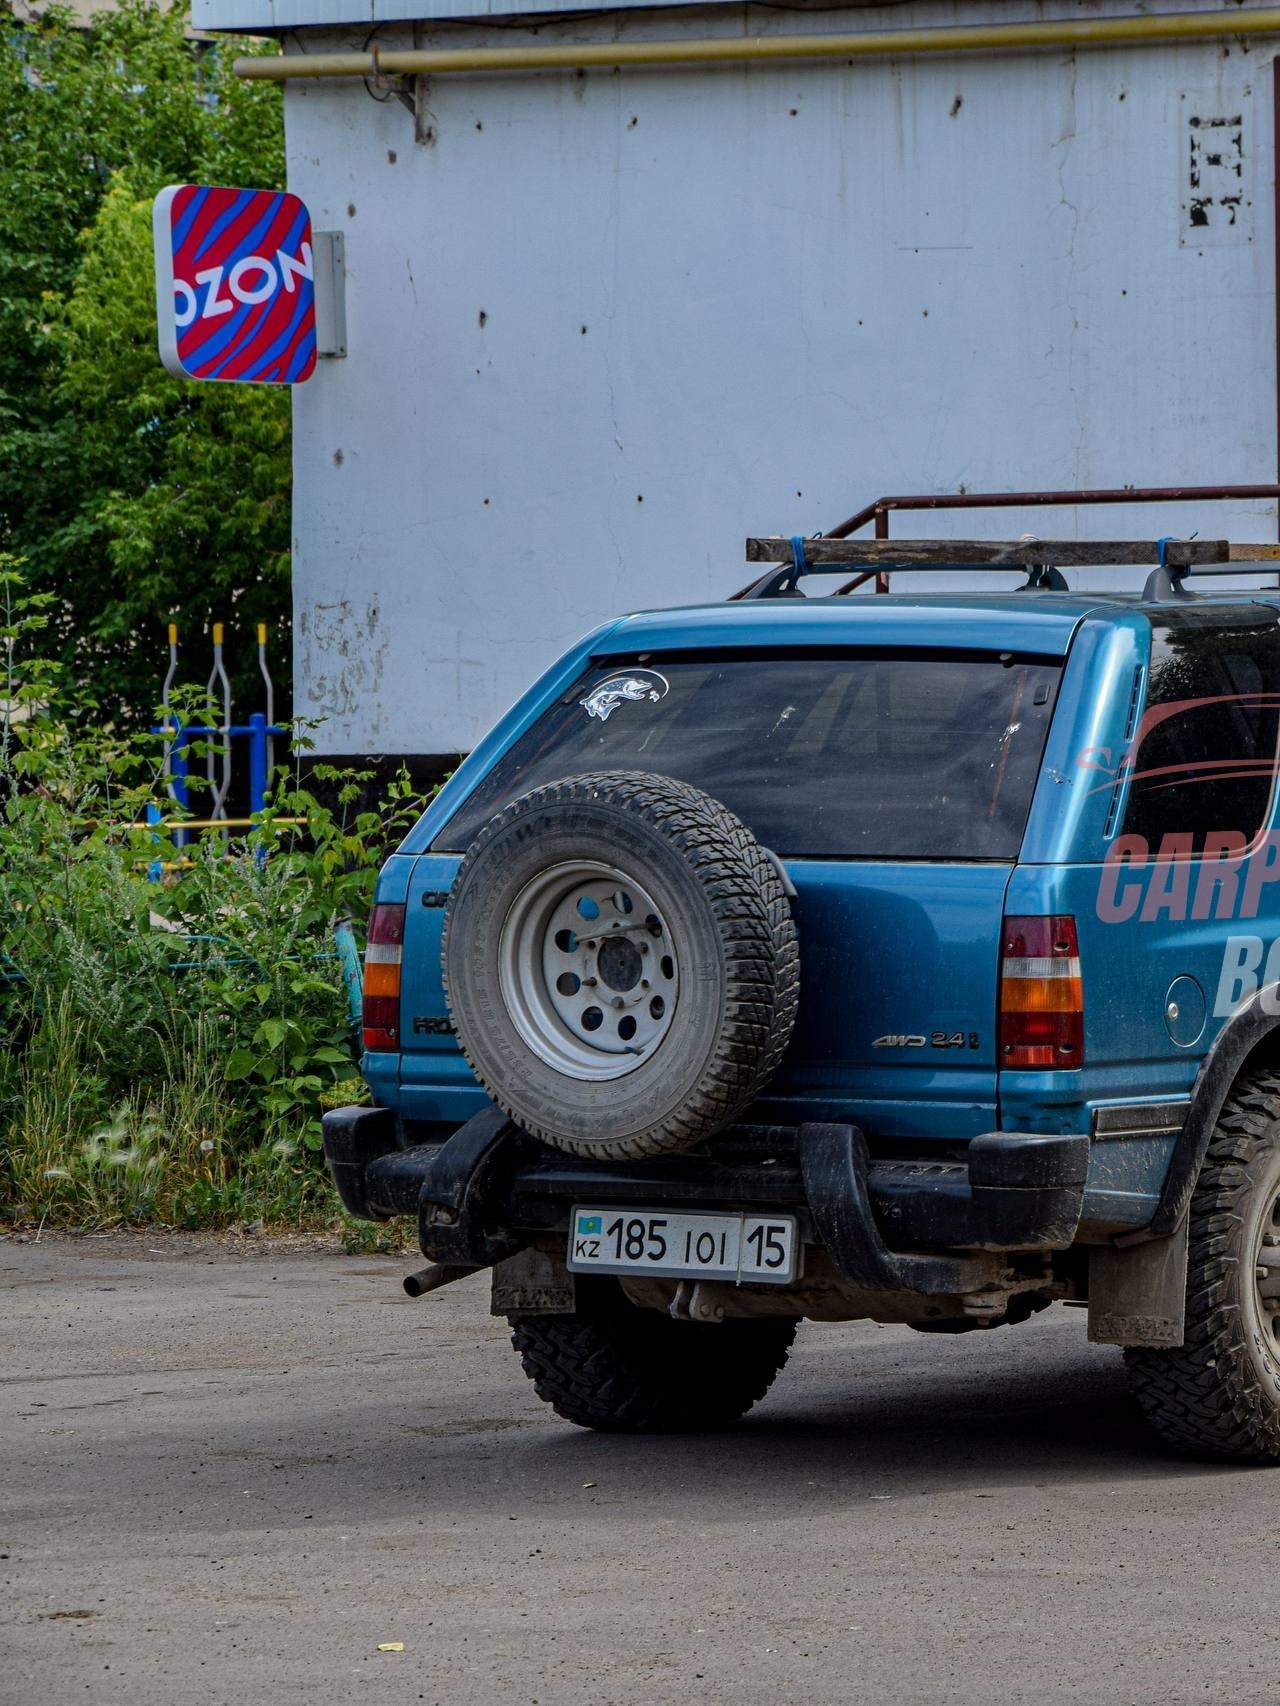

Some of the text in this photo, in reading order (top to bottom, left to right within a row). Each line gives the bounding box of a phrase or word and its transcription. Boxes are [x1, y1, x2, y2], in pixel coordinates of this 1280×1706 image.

[174, 242, 314, 327] OZON
[575, 1240, 600, 1258] KZ
[606, 1217, 668, 1261] 185
[747, 1225, 786, 1268] 15
